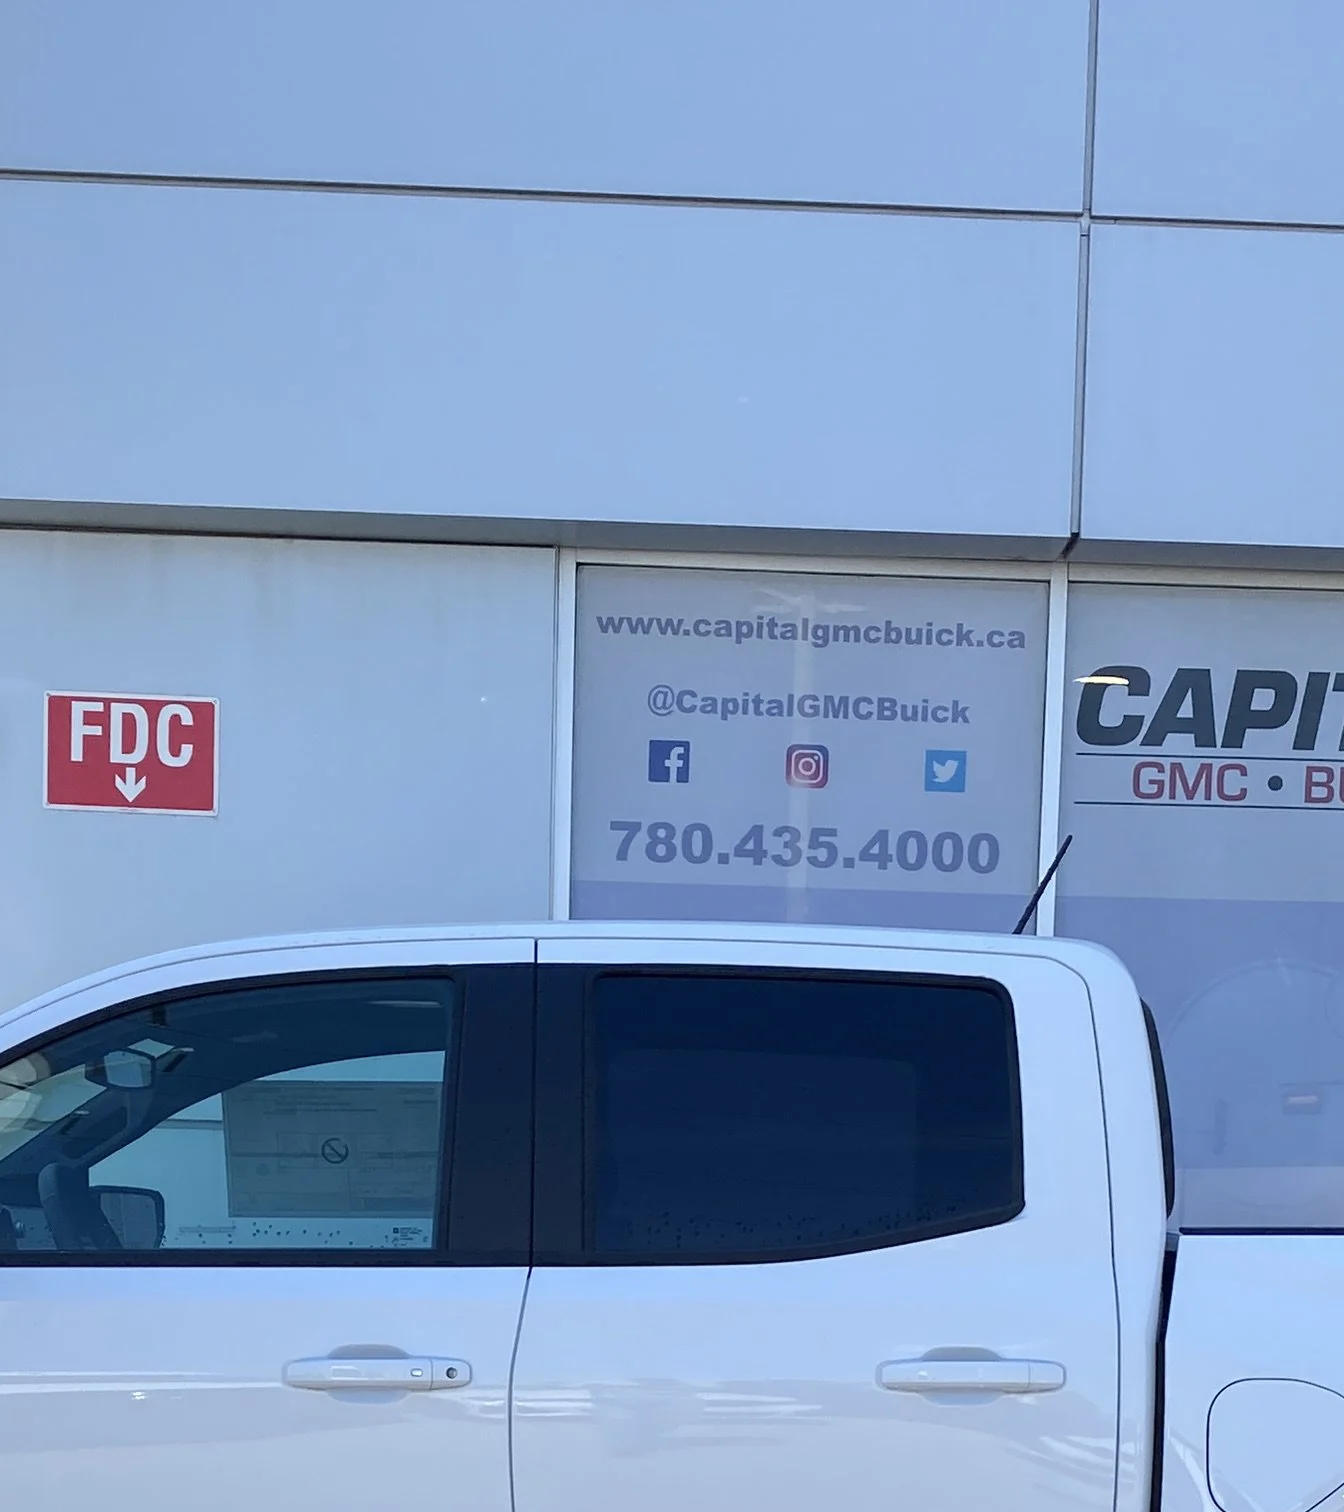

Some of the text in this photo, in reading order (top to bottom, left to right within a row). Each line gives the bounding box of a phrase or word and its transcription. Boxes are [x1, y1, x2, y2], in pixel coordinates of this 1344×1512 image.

[596, 614, 1026, 649] www.capitalgmcbuick.ca
[647, 684, 971, 724] @CapitalGMCBuick
[70, 700, 194, 768] FDC
[1132, 761, 1249, 802] GMC
[609, 820, 1001, 875] 780.435.4000
